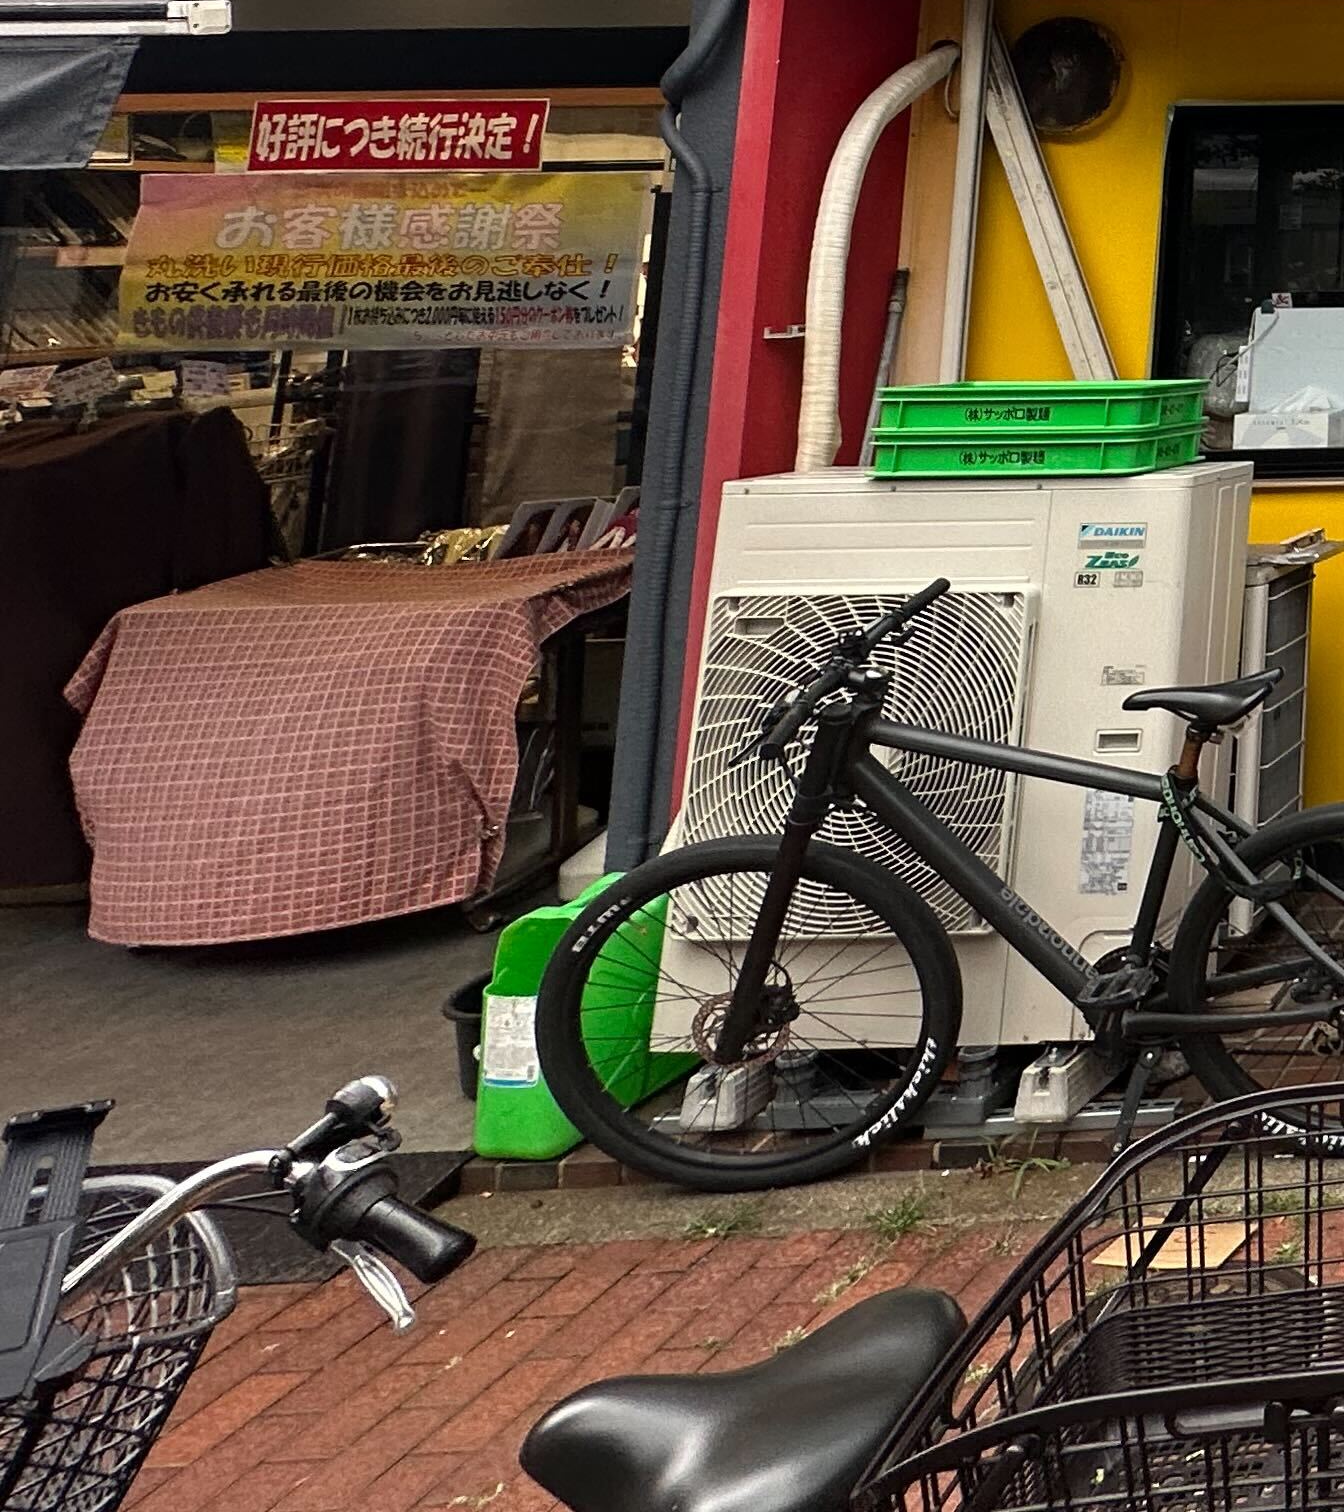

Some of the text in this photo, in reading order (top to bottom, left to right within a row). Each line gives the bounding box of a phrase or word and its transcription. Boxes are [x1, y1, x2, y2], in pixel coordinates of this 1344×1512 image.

[256, 112, 541, 162] 好評につき続行決定！
[214, 201, 567, 251] お客様感謝祭
[1094, 527, 1145, 536] DAIKIN
[1104, 551, 1129, 559] Eco
[1077, 574, 1097, 585] R32
[1001, 887, 1100, 981] annondale
